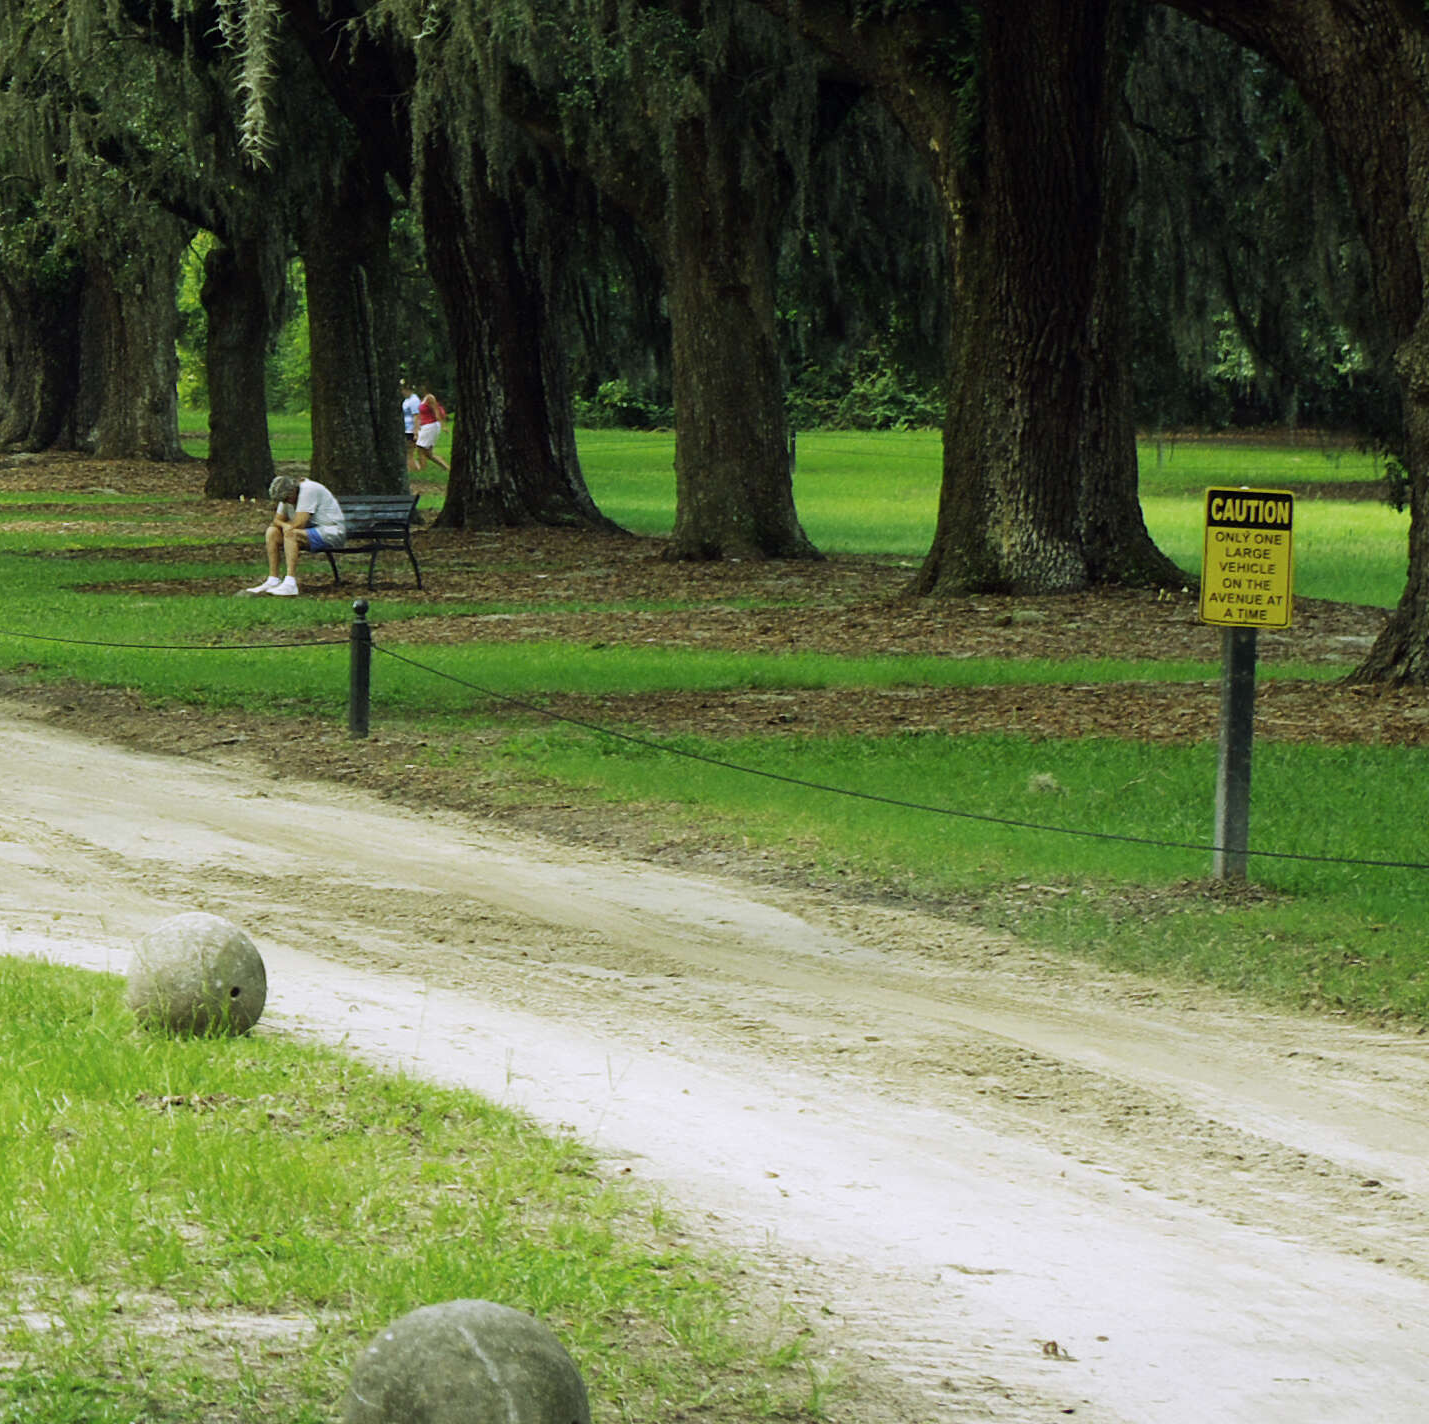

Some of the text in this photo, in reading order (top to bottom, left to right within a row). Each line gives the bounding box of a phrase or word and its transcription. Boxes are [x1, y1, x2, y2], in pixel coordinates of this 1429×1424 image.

[1211, 497, 1290, 524] CAUTION
[1215, 531, 1282, 545] ONLY ONE
[1225, 548, 1270, 560] LARGE
[1219, 562, 1276, 574] VEHICLE
[1222, 578, 1271, 591] ON THE
[1209, 592, 1283, 606] AVENUE AT
[1224, 608, 1267, 620] A TIME
